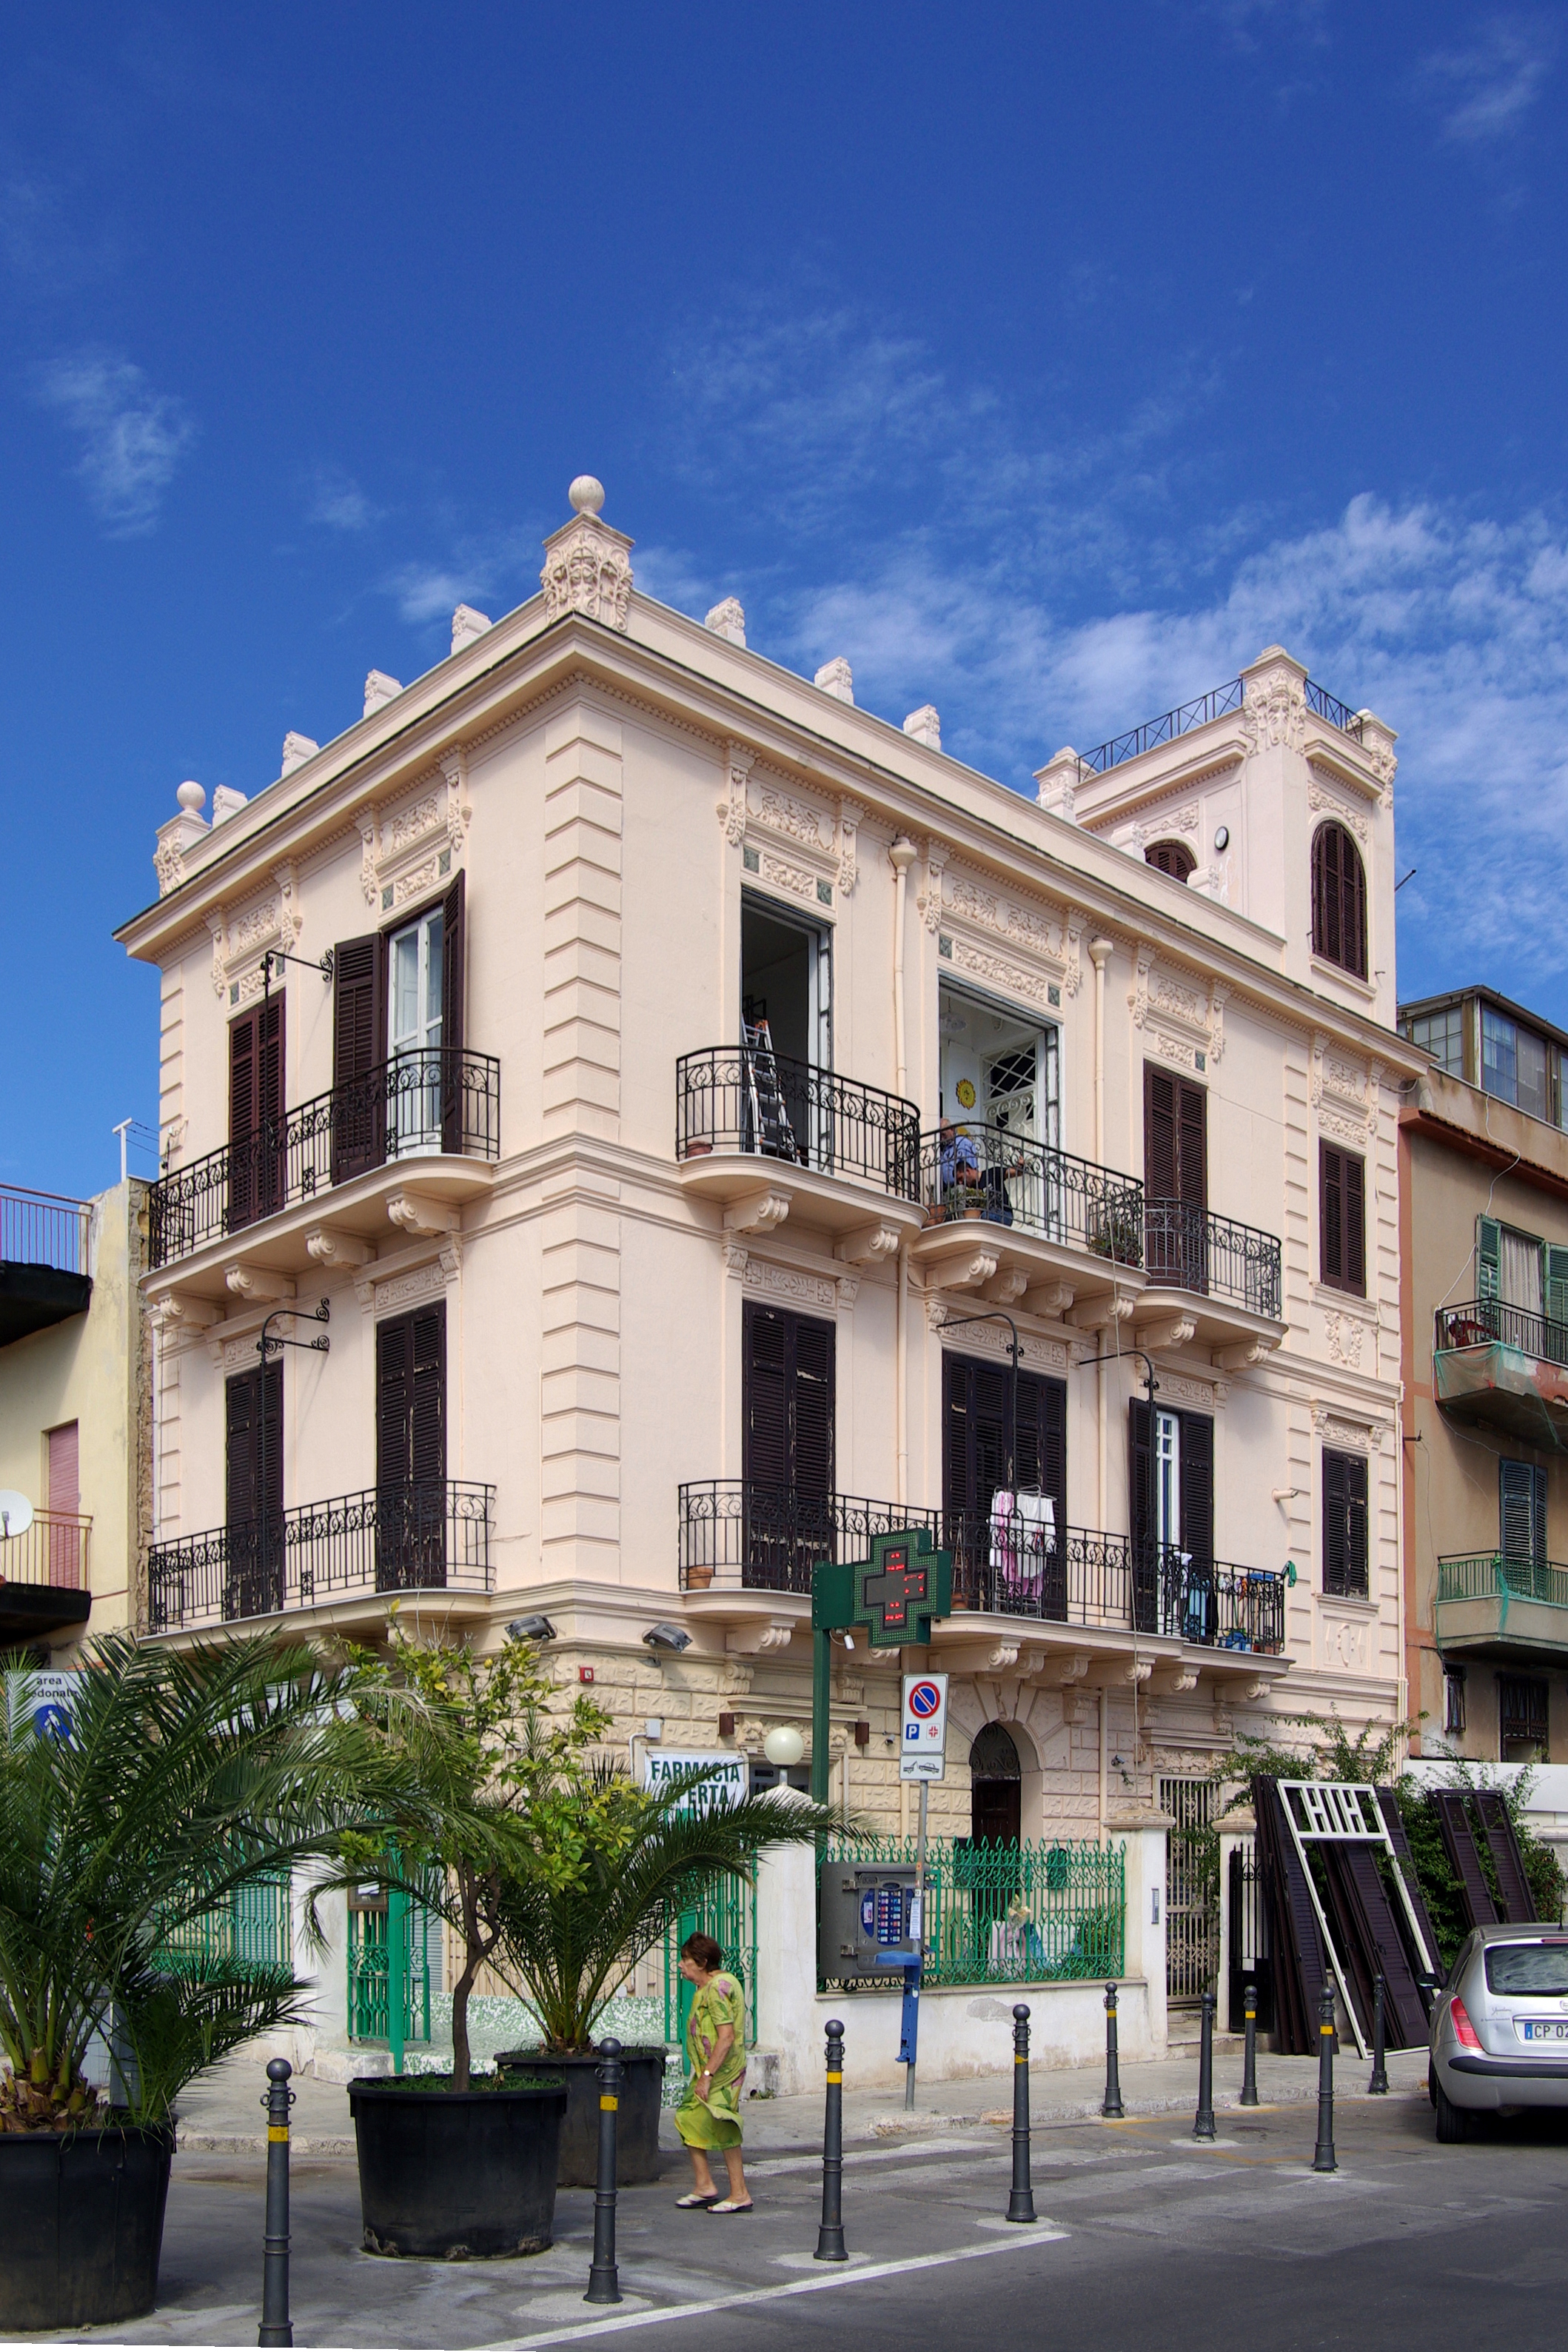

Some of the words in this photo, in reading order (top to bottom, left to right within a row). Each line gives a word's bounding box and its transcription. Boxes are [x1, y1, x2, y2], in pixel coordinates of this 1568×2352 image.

[908, 1725, 917, 1739] P
[667, 1785, 729, 1804] ERTA
[1535, 2025, 1550, 2037] CP
